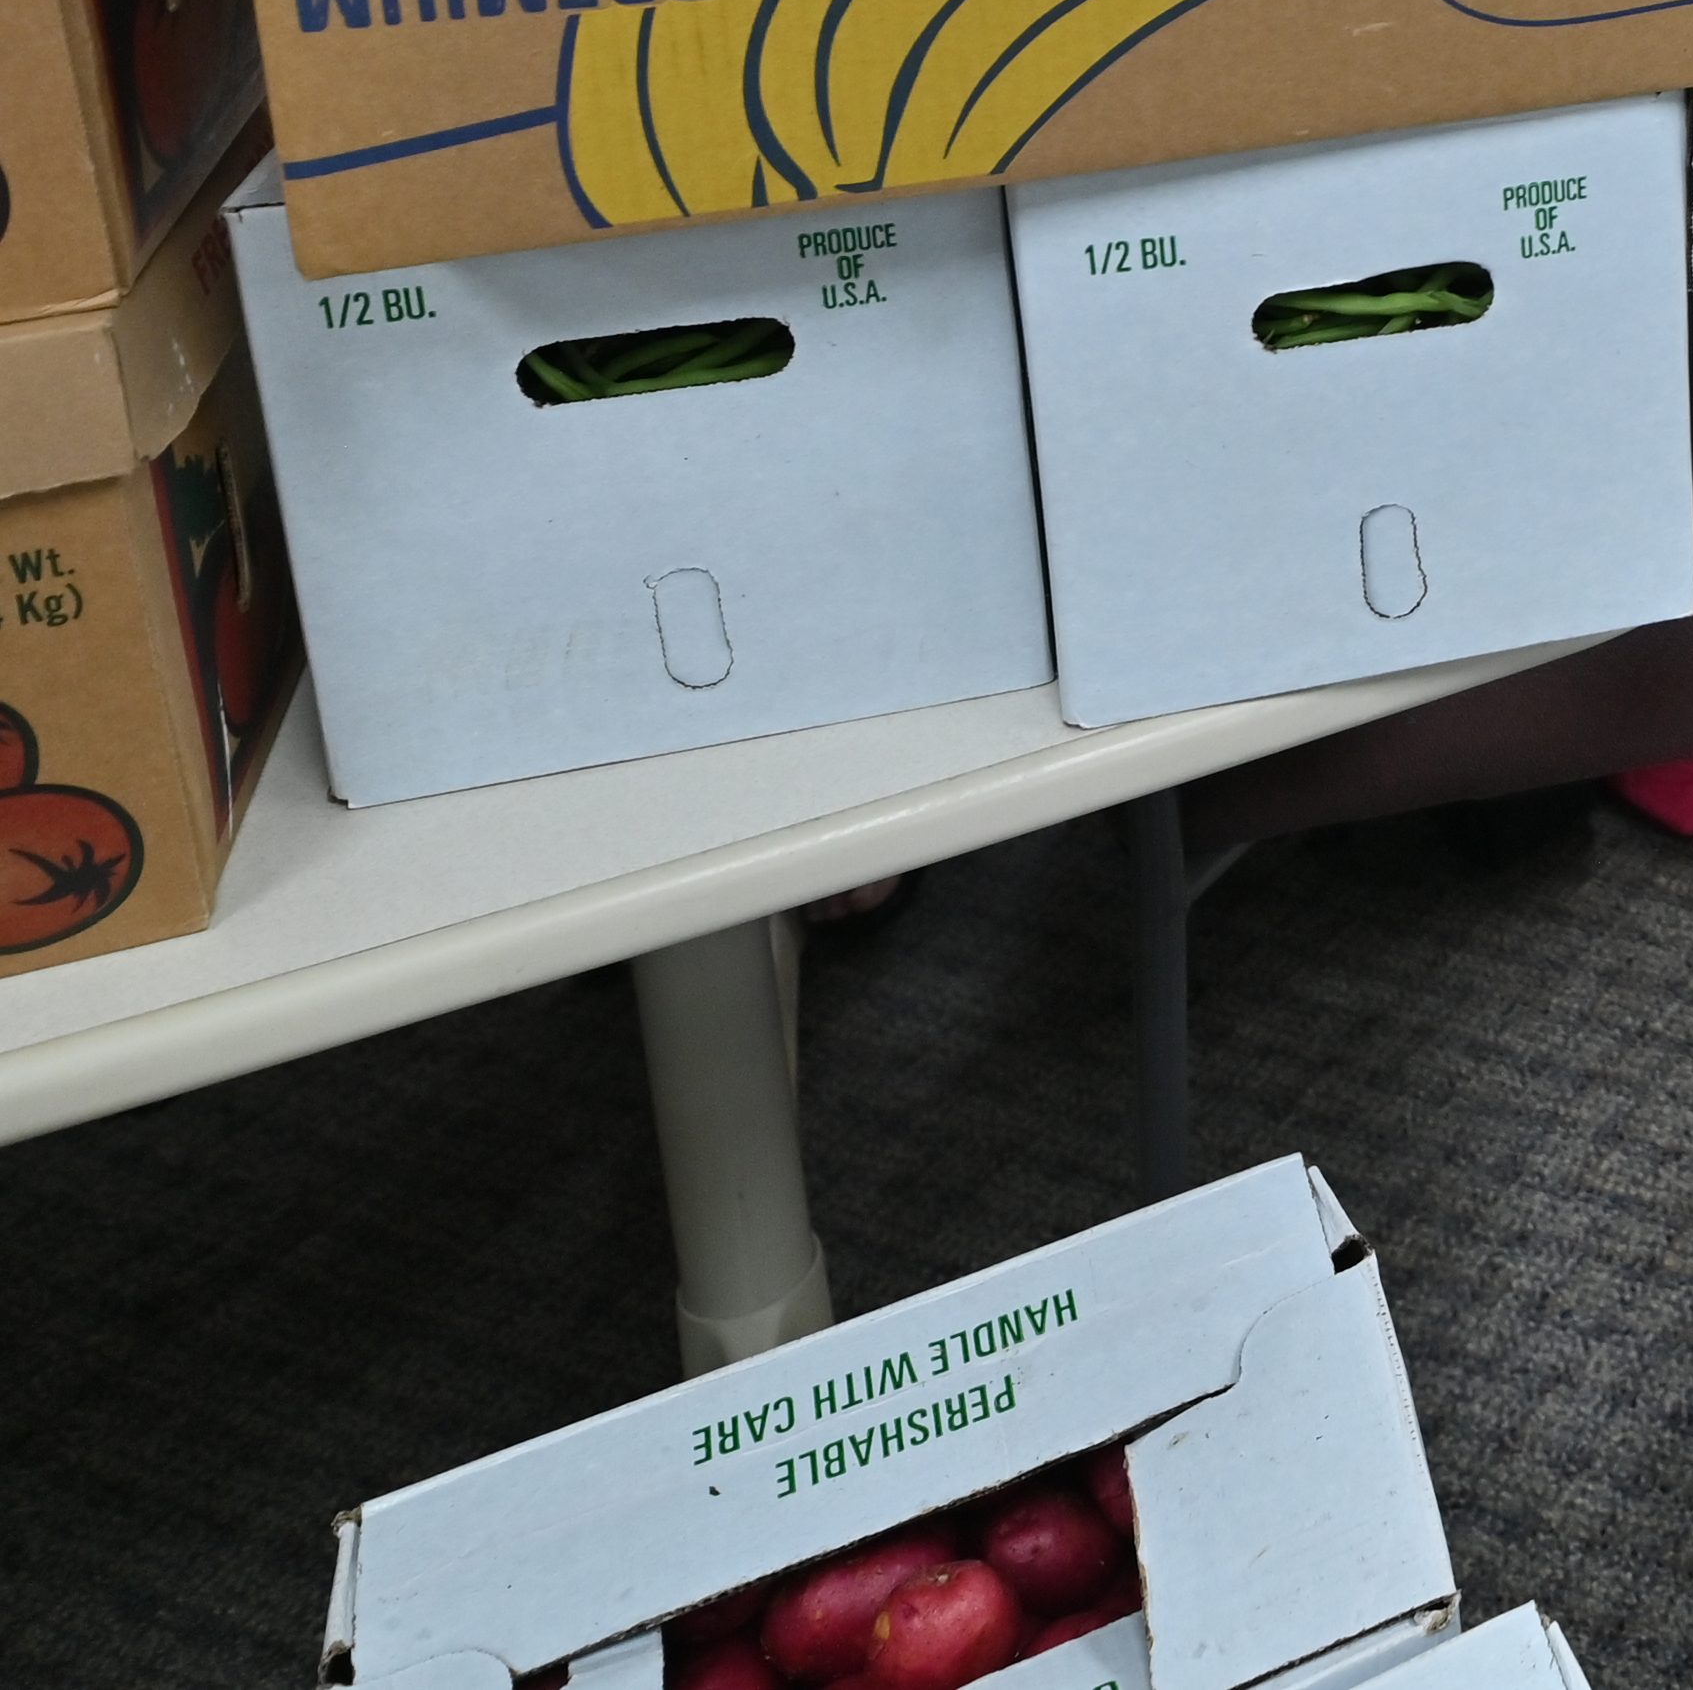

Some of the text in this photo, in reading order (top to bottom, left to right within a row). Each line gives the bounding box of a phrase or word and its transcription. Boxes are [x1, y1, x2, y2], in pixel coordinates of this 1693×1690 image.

[1502, 175, 1588, 211] PRODUCE
[1534, 207, 1560, 232] OF
[797, 222, 898, 259] PRODUCE
[1084, 235, 1187, 277] 1/2 BU.
[1520, 230, 1577, 260] U.S.A.
[836, 254, 866, 282] OF
[318, 285, 437, 330] 1/2 BU.
[821, 280, 888, 310] U.S.A.
[8, 548, 76, 584] Wt.
[15, 583, 84, 627] Kg)
[691, 1288, 1079, 1467] HANDLE WITH CARE
[774, 1373, 1017, 1500] PERISHABLE
